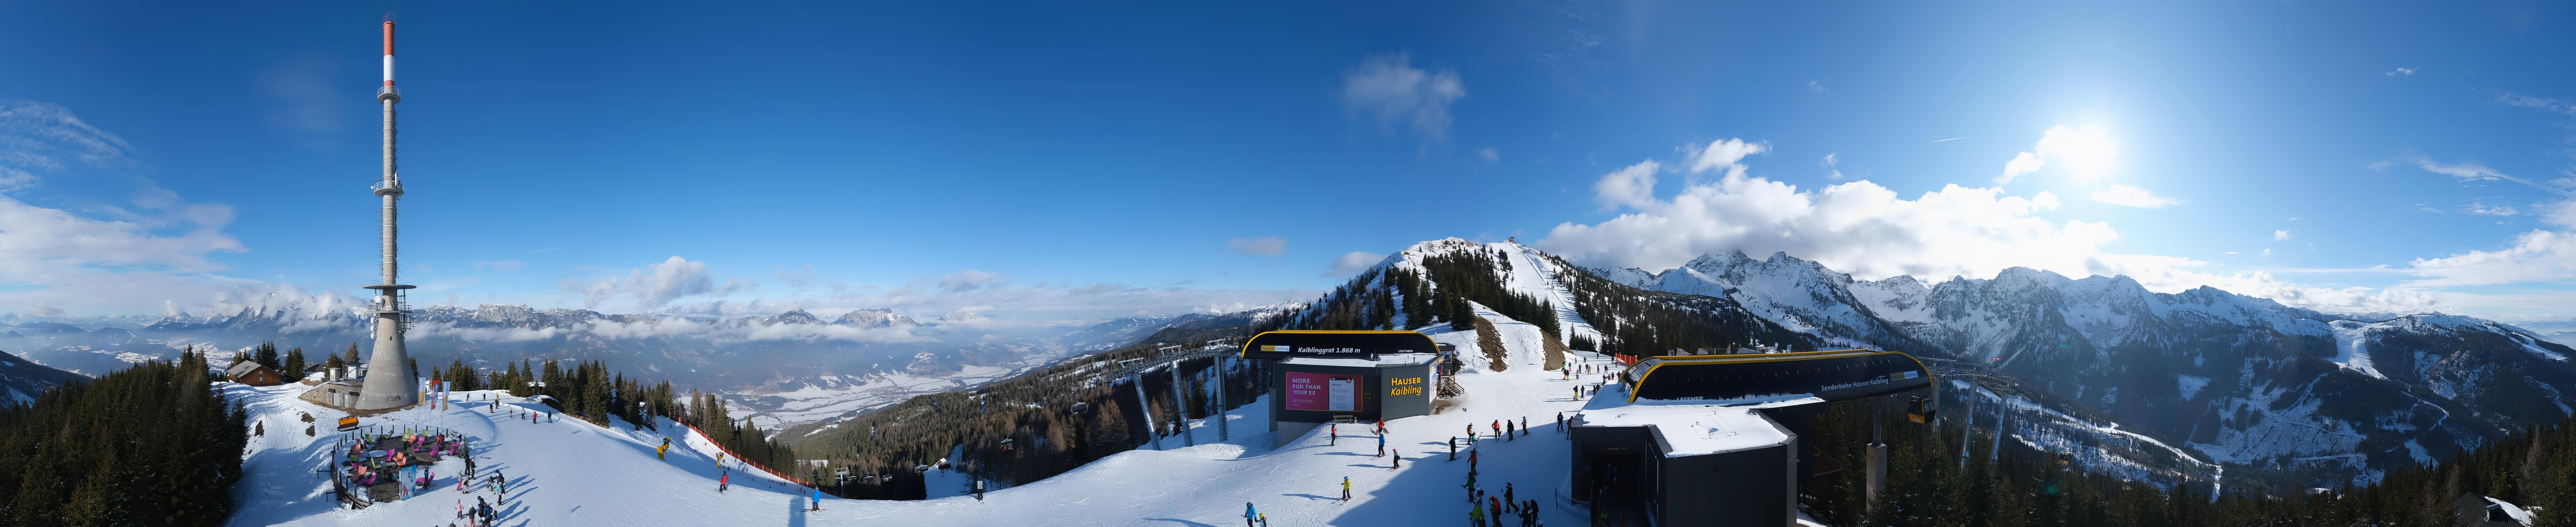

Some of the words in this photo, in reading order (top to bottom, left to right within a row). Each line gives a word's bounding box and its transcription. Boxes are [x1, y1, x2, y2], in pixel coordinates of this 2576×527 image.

[1392, 377, 1421, 386] HAUSER
[1391, 386, 1421, 396] Kaibling
[1821, 382, 1852, 391] Senderbahn
